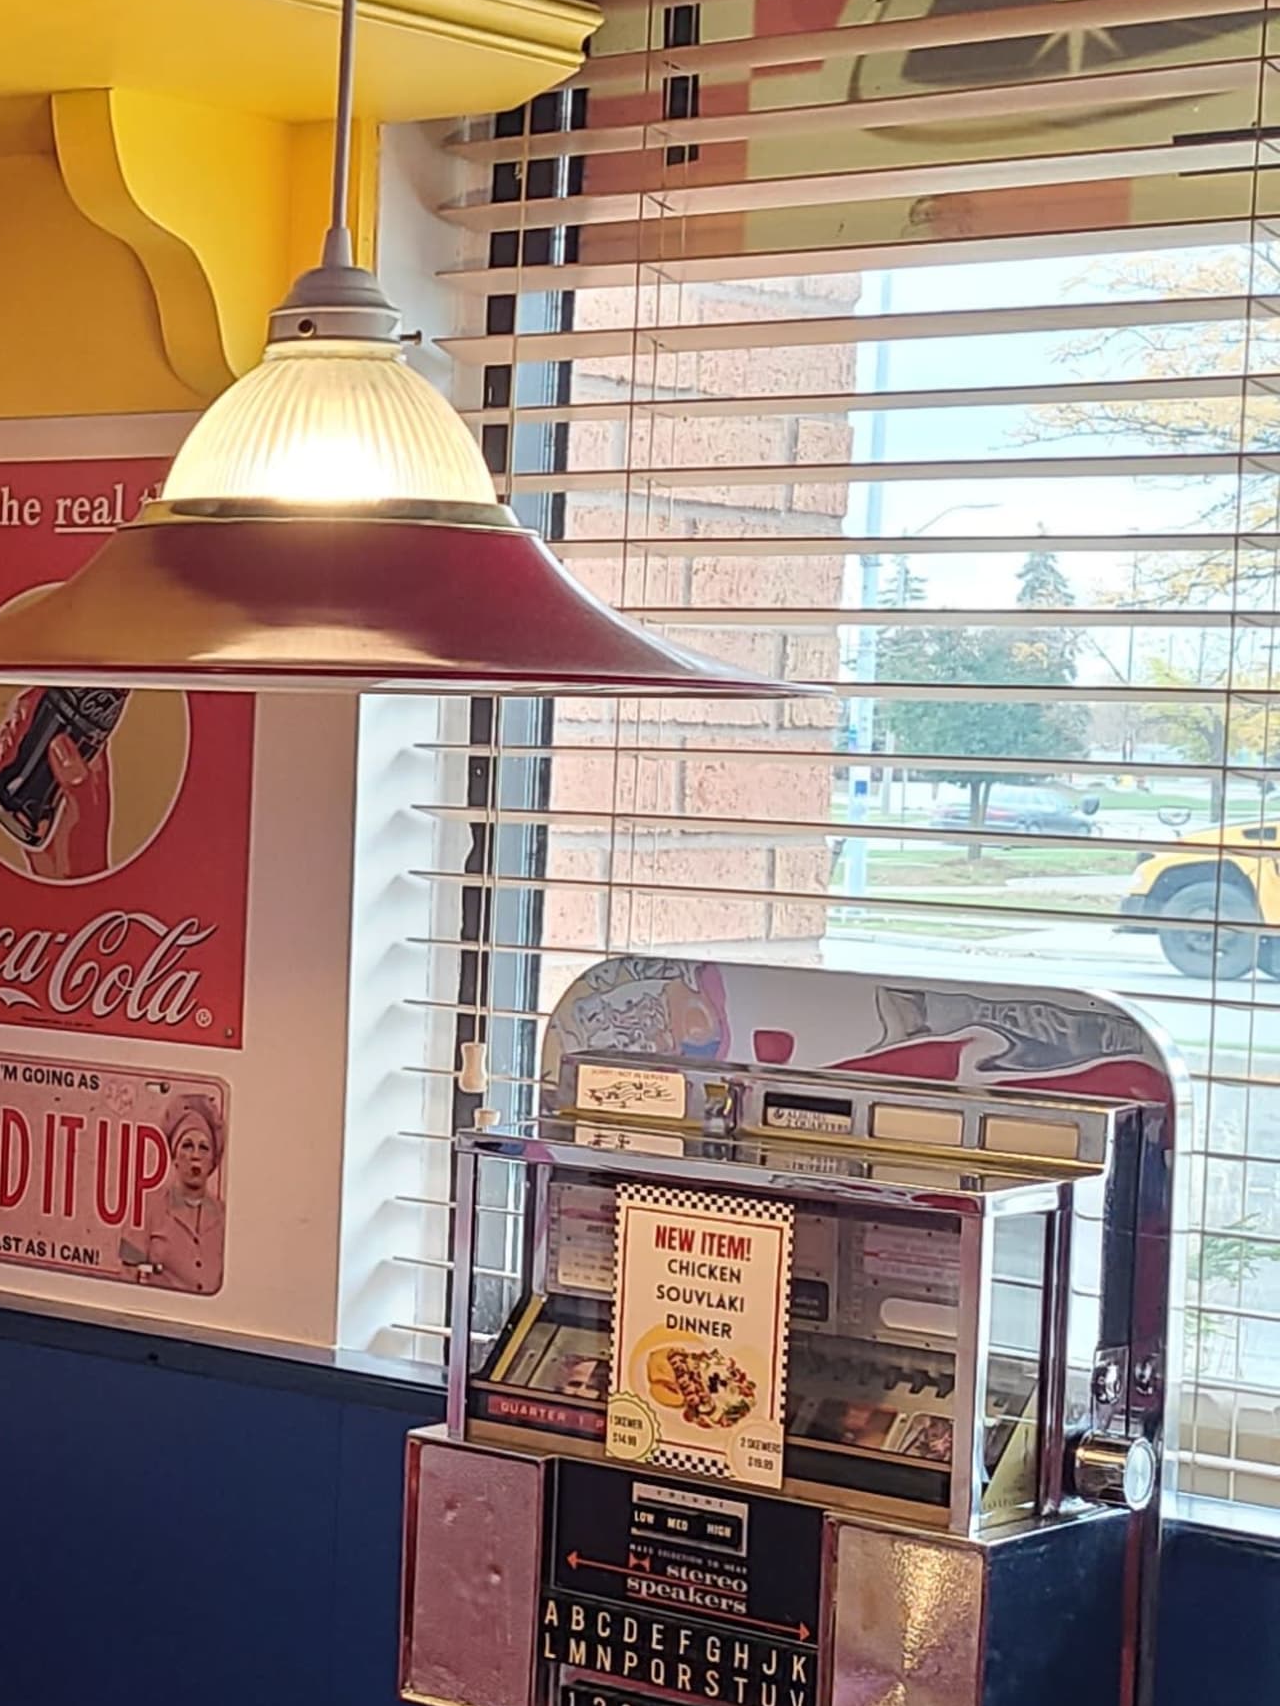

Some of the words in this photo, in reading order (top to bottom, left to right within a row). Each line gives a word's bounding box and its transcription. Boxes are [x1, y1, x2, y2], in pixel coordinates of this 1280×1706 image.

[54, 483, 124, 526] real
[26, 1065, 71, 1089] GOING
[76, 1071, 101, 1091] AS
[95, 1122, 170, 1230] UP
[26, 1235, 48, 1256] AS
[654, 1224, 695, 1253] NEW
[667, 1258, 741, 1284] CHICKEN
[655, 1284, 744, 1313] SOUVLAKI
[665, 1313, 732, 1340] DINNER
[665, 1561, 749, 1592] stereo
[626, 1575, 749, 1615] speakers
